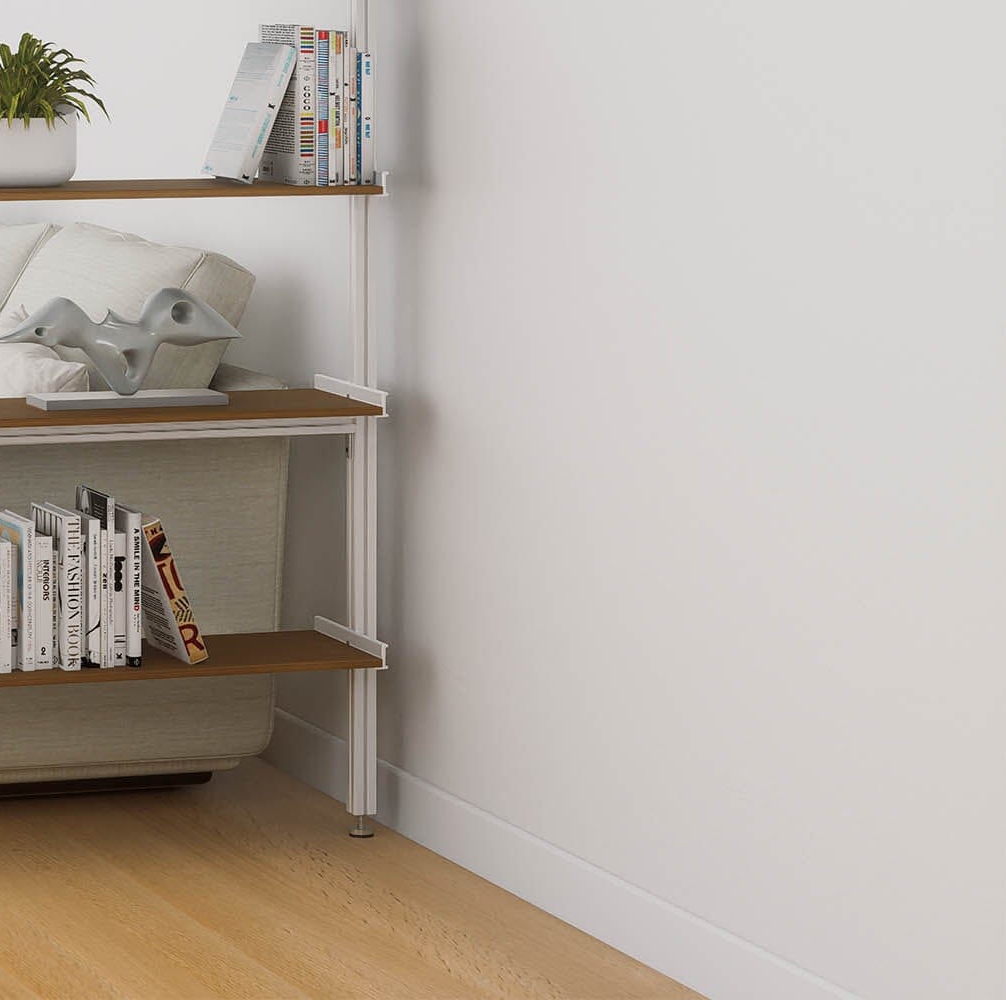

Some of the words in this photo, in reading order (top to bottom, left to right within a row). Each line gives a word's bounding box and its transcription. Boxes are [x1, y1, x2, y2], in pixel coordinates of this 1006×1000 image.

[67, 518, 80, 549] THE
[133, 561, 140, 569] IN
[67, 554, 80, 620] FASHION
[67, 625, 80, 667] BOOK
